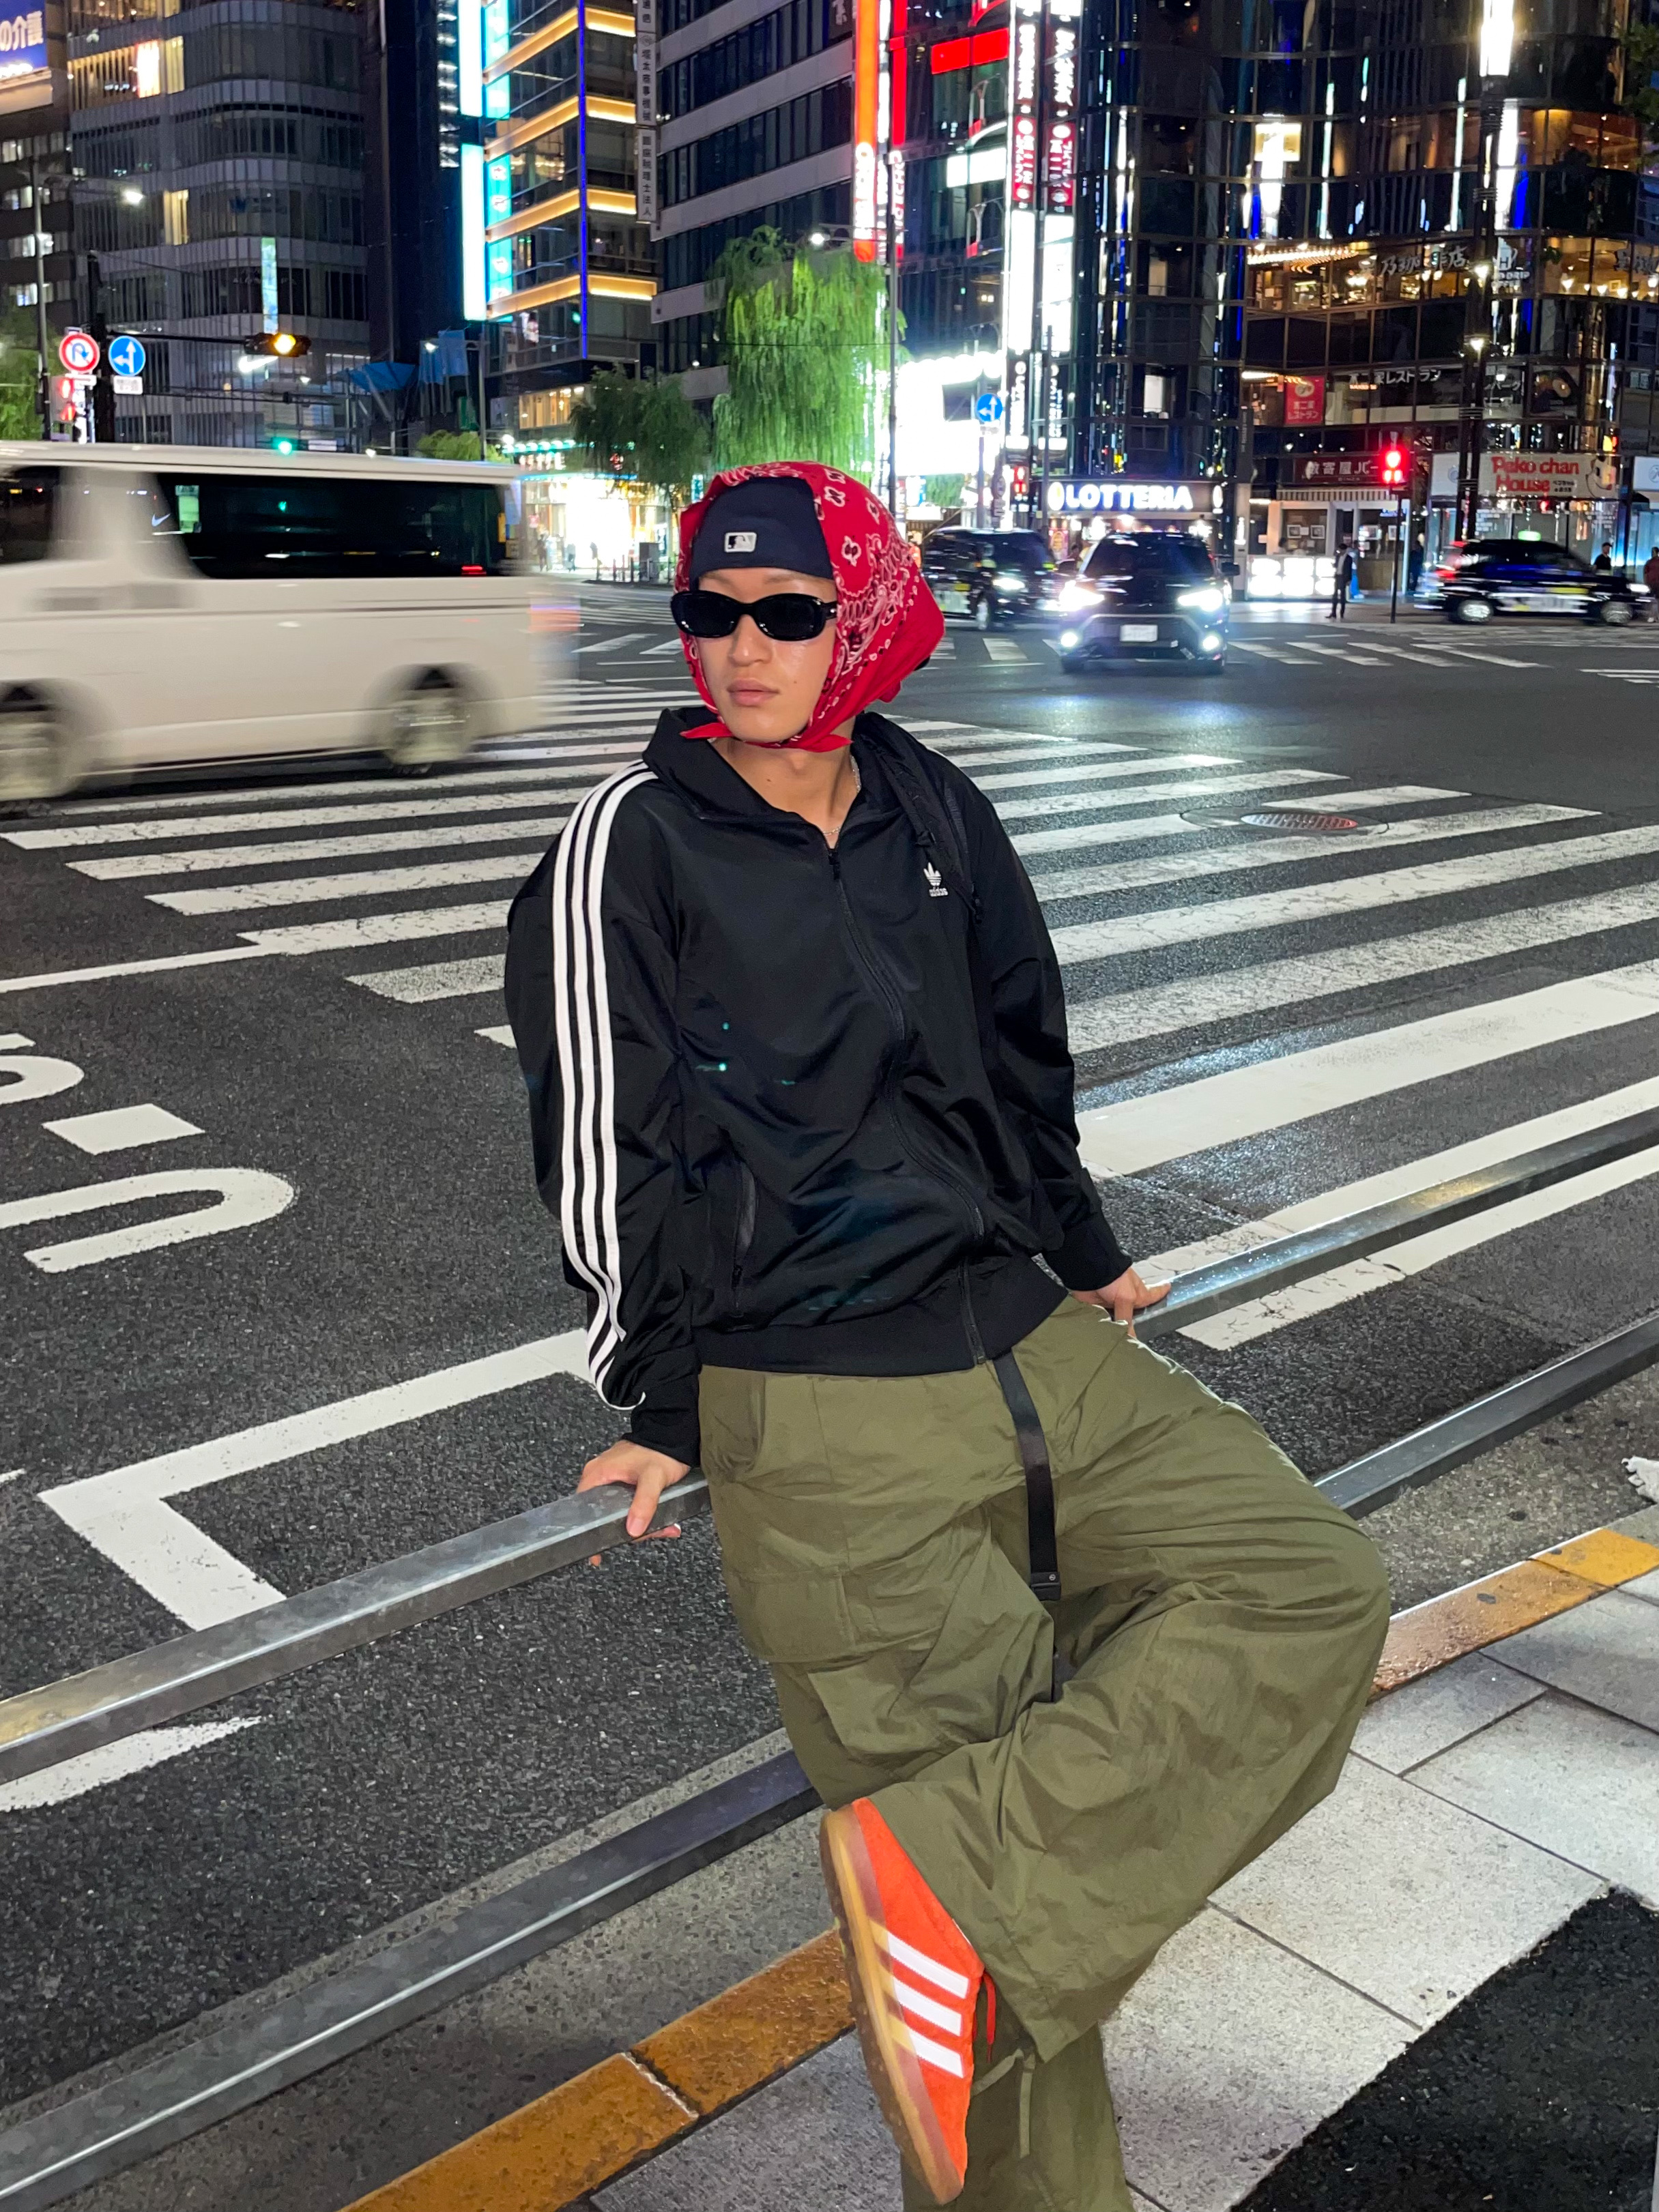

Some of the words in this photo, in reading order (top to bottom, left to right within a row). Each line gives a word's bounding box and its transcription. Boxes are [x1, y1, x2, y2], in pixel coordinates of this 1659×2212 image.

[1540, 458, 1579, 474] chan
[1496, 475, 1550, 492] House
[1065, 484, 1194, 510] LOTTERIA
